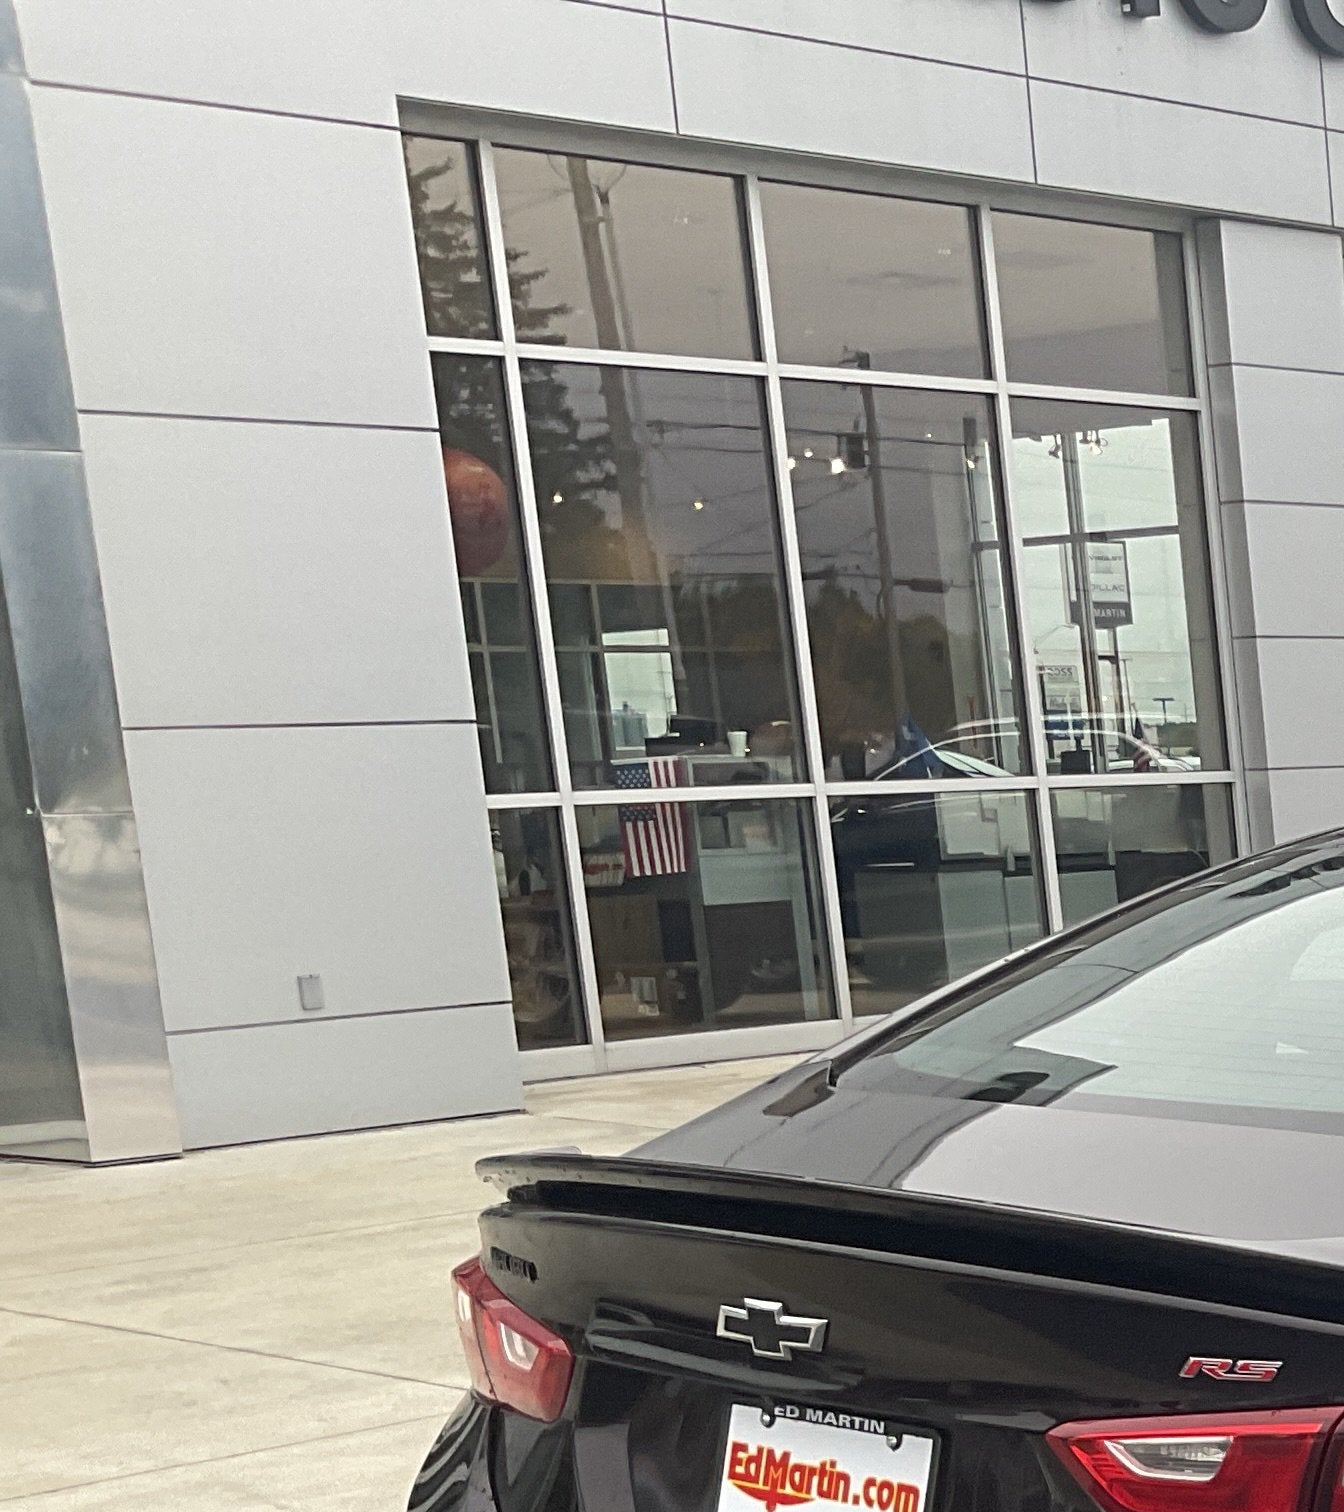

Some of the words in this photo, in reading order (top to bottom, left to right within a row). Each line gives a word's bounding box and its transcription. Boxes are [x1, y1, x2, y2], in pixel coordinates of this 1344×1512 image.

[1178, 1356, 1284, 1382] RS
[773, 1406, 800, 1418] ED
[805, 1410, 885, 1434] MARTIN
